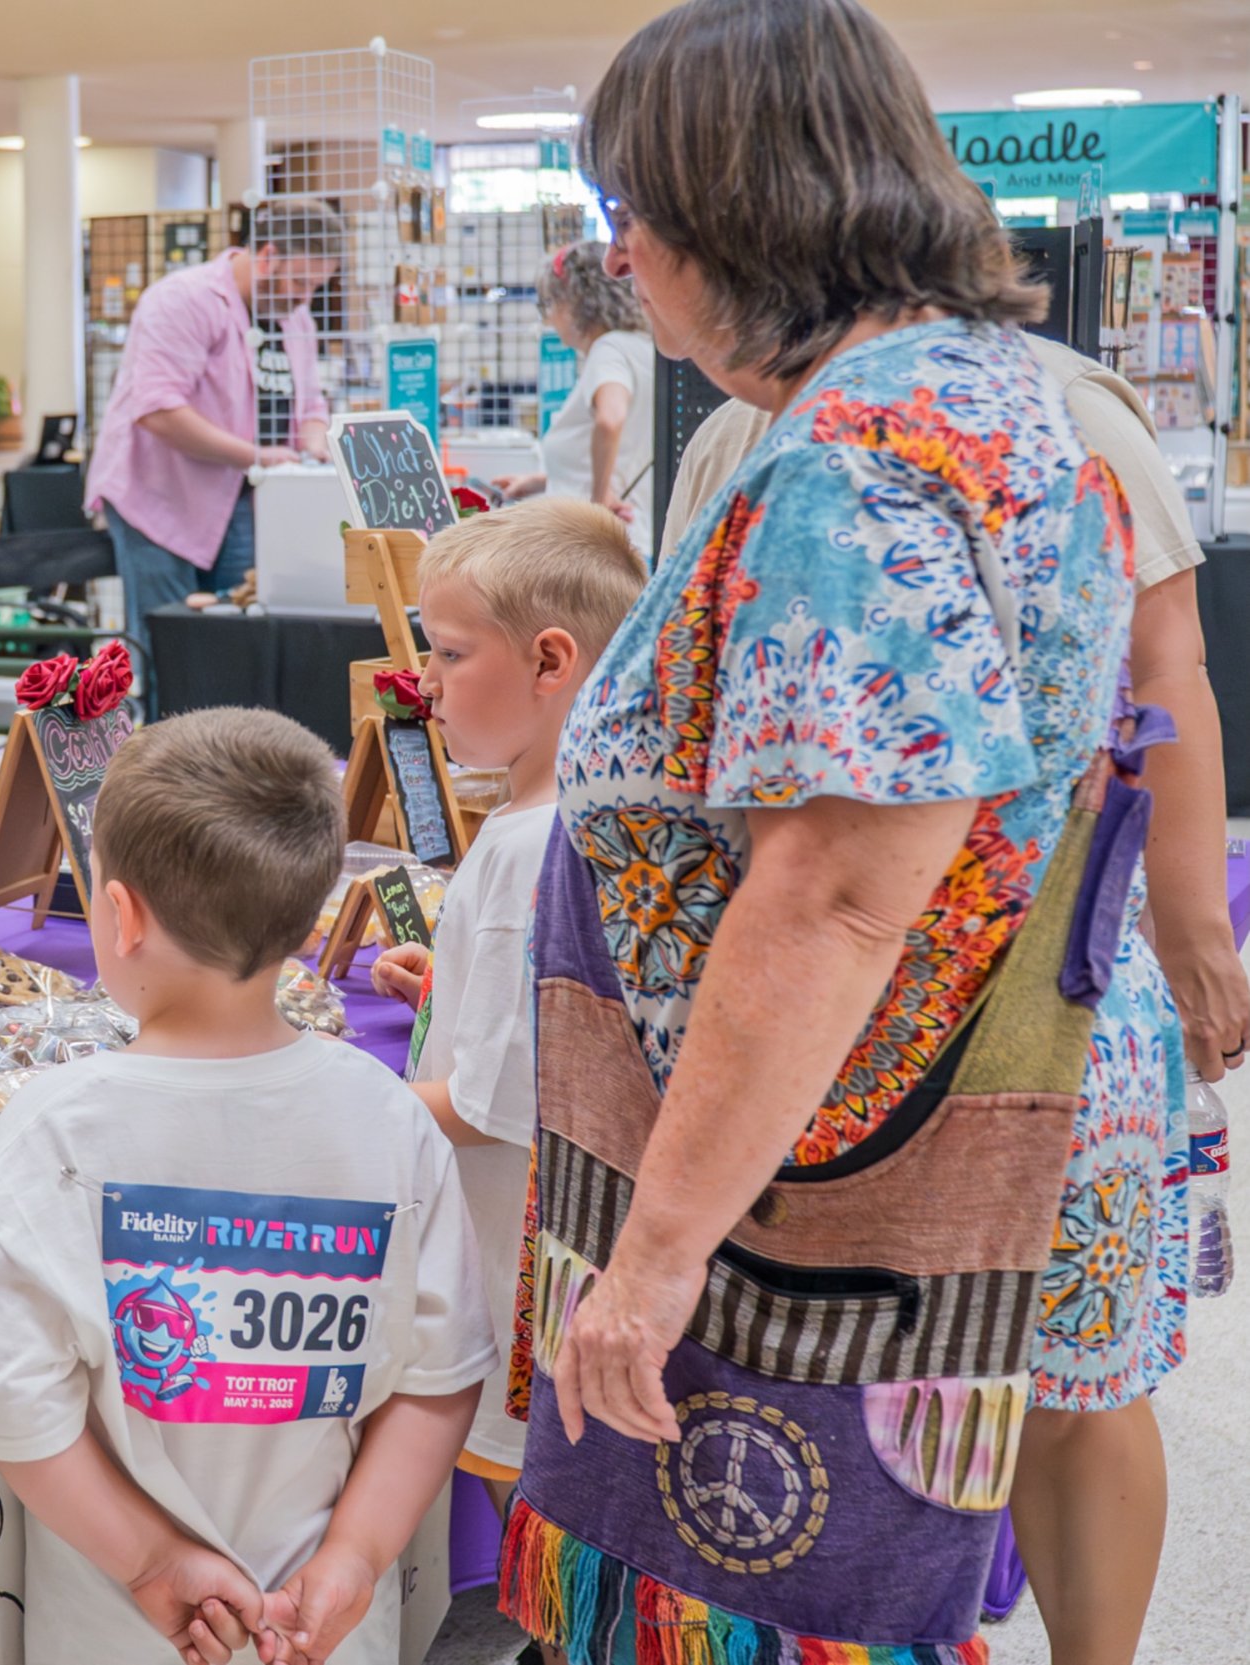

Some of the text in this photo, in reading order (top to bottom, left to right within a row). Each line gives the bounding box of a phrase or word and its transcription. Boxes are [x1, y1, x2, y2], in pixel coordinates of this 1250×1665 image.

[1006, 171, 1088, 188] And Mor
[343, 430, 422, 480] What
[360, 478, 441, 526] Diet?
[377, 882, 407, 903] Lemon
[120, 1211, 198, 1240] Fidelity
[310, 1224, 381, 1256] RUN
[153, 1233, 186, 1243] BANK
[230, 1288, 369, 1352] 3026
[225, 1376, 297, 1392] TOT TROT
[223, 1397, 293, 1409] MAY 31, 2025
